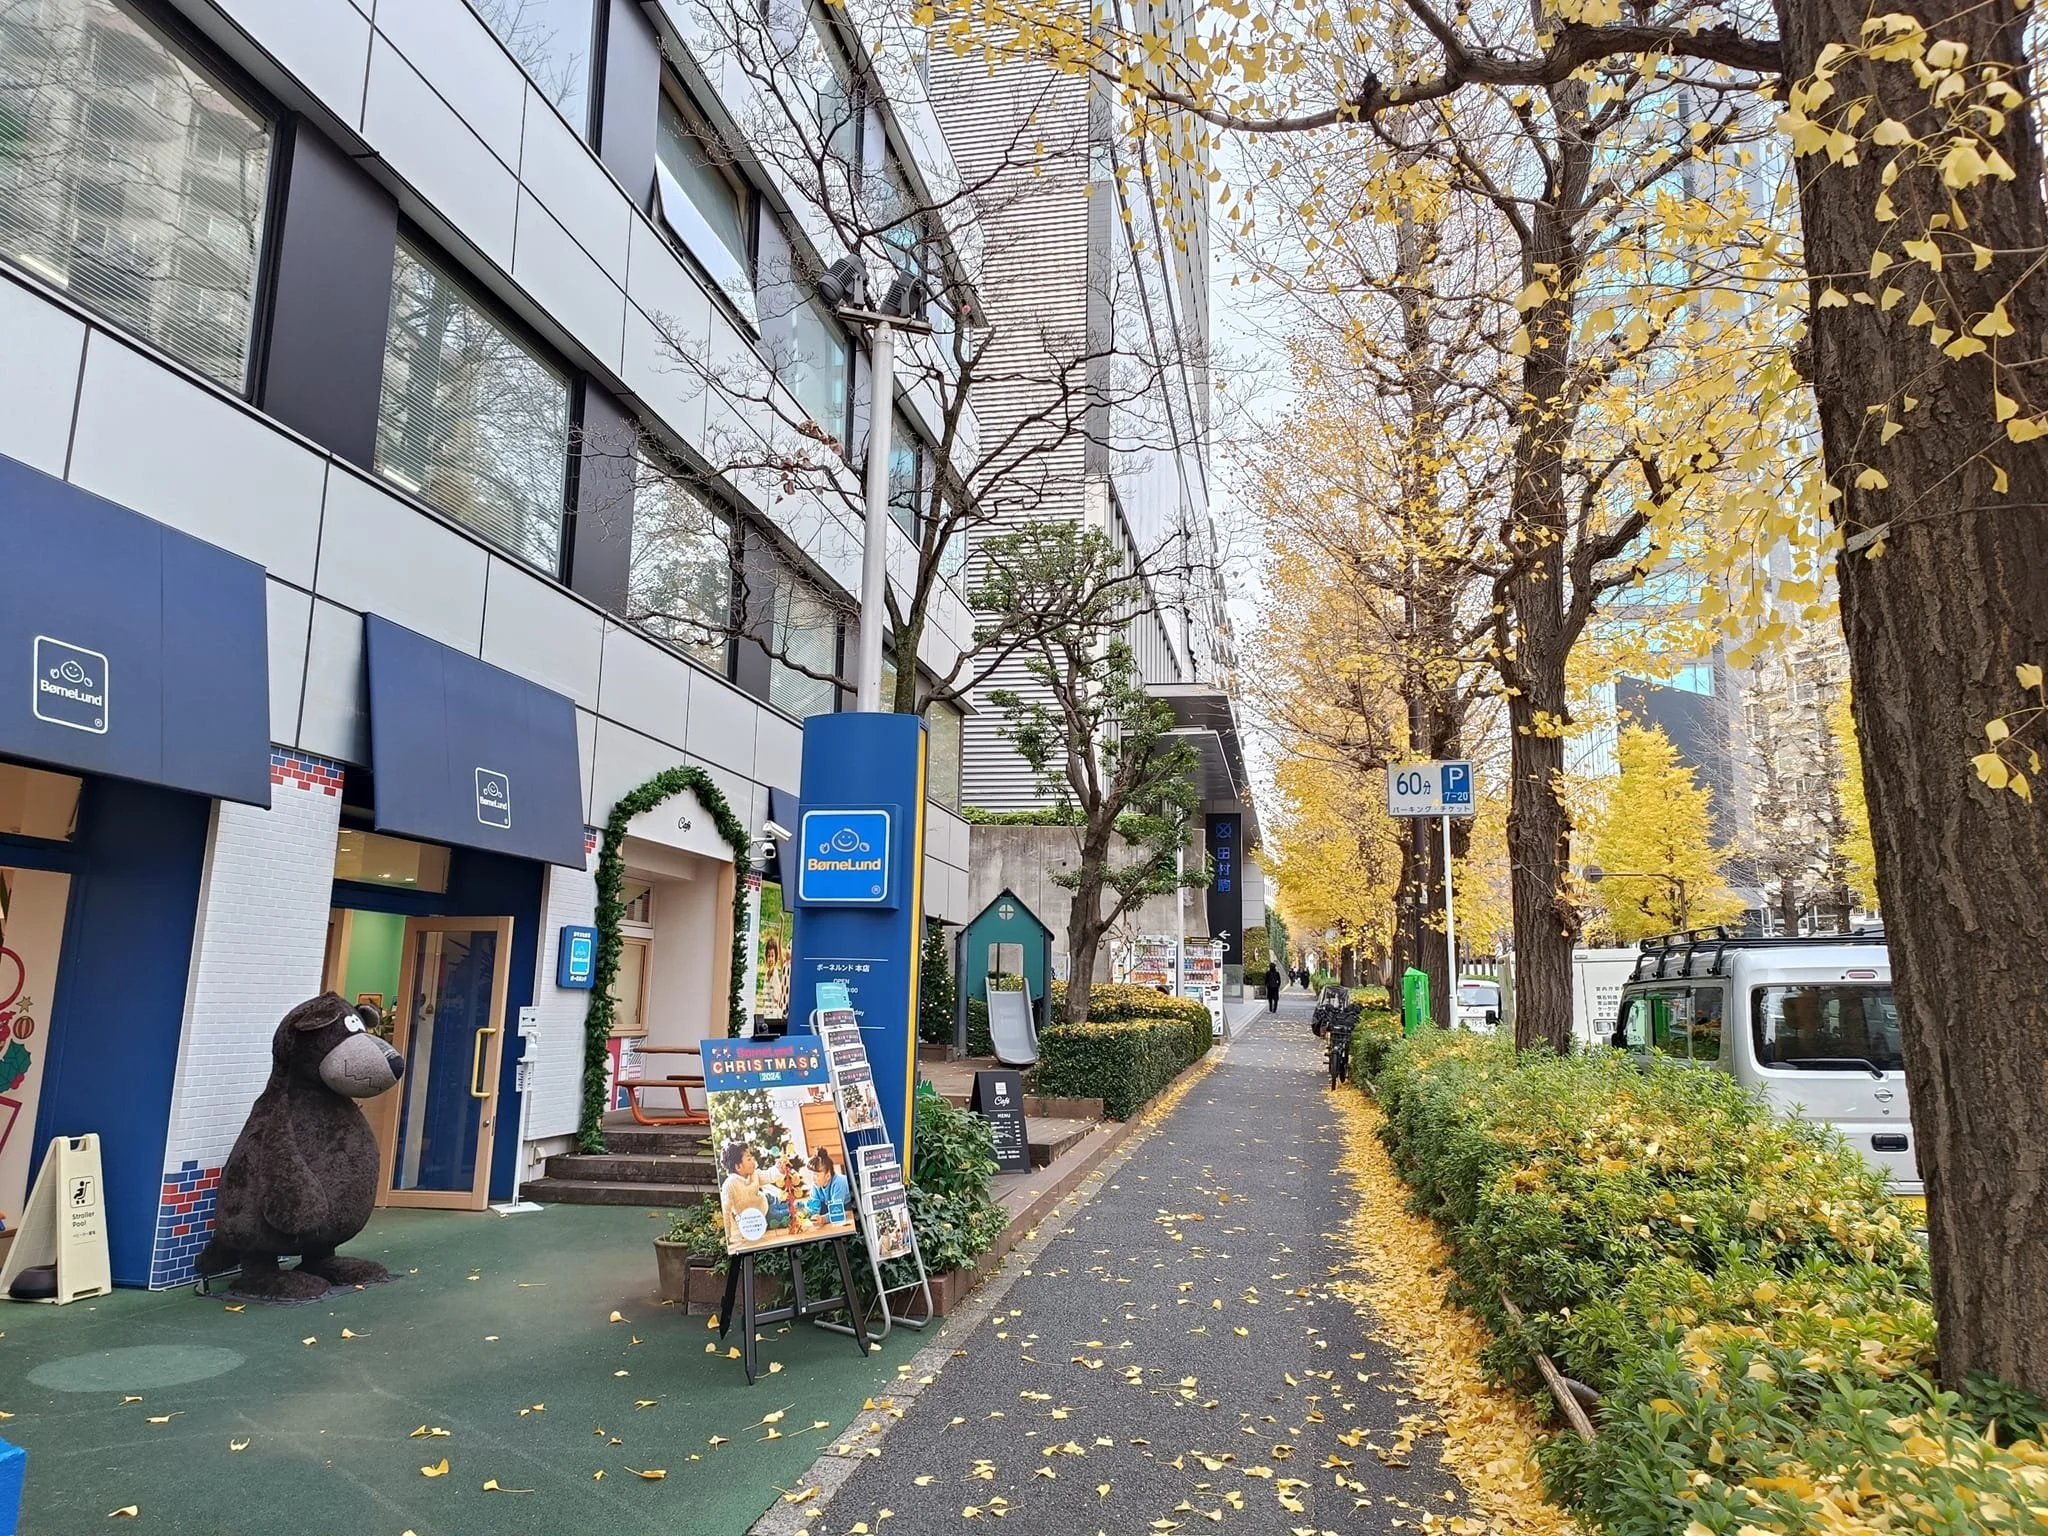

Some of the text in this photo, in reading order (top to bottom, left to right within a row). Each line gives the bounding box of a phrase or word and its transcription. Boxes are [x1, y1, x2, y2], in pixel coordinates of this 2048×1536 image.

[40, 679, 103, 706] BørneLund
[807, 858, 882, 871] BørneLund
[1217, 846, 1231, 892] 田村駒
[712, 1056, 809, 1074] CHRISTMAS
[72, 1219, 87, 1228] Pool
